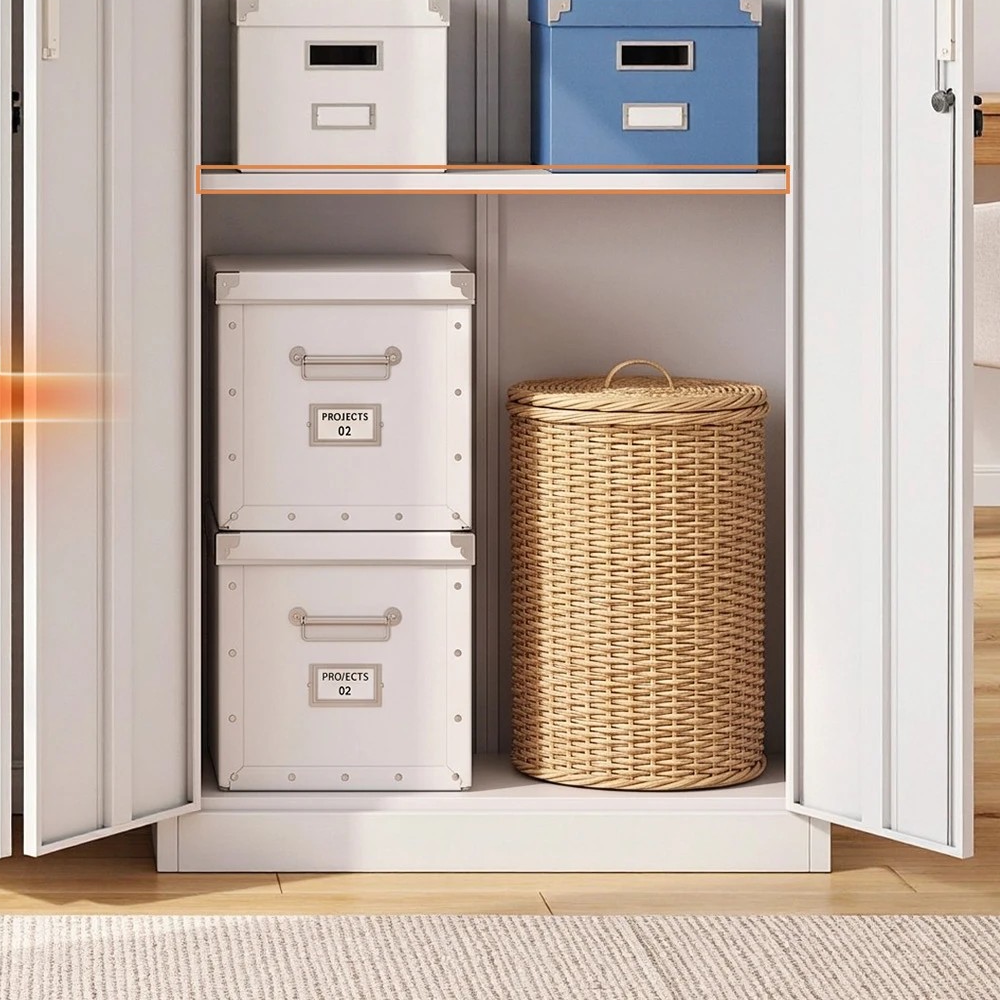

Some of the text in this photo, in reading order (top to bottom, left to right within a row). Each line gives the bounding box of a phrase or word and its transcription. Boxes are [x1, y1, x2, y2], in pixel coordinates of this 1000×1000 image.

[322, 412, 369, 422] PROJECTS
[338, 425, 351, 436] 02
[338, 685, 352, 696] 02
